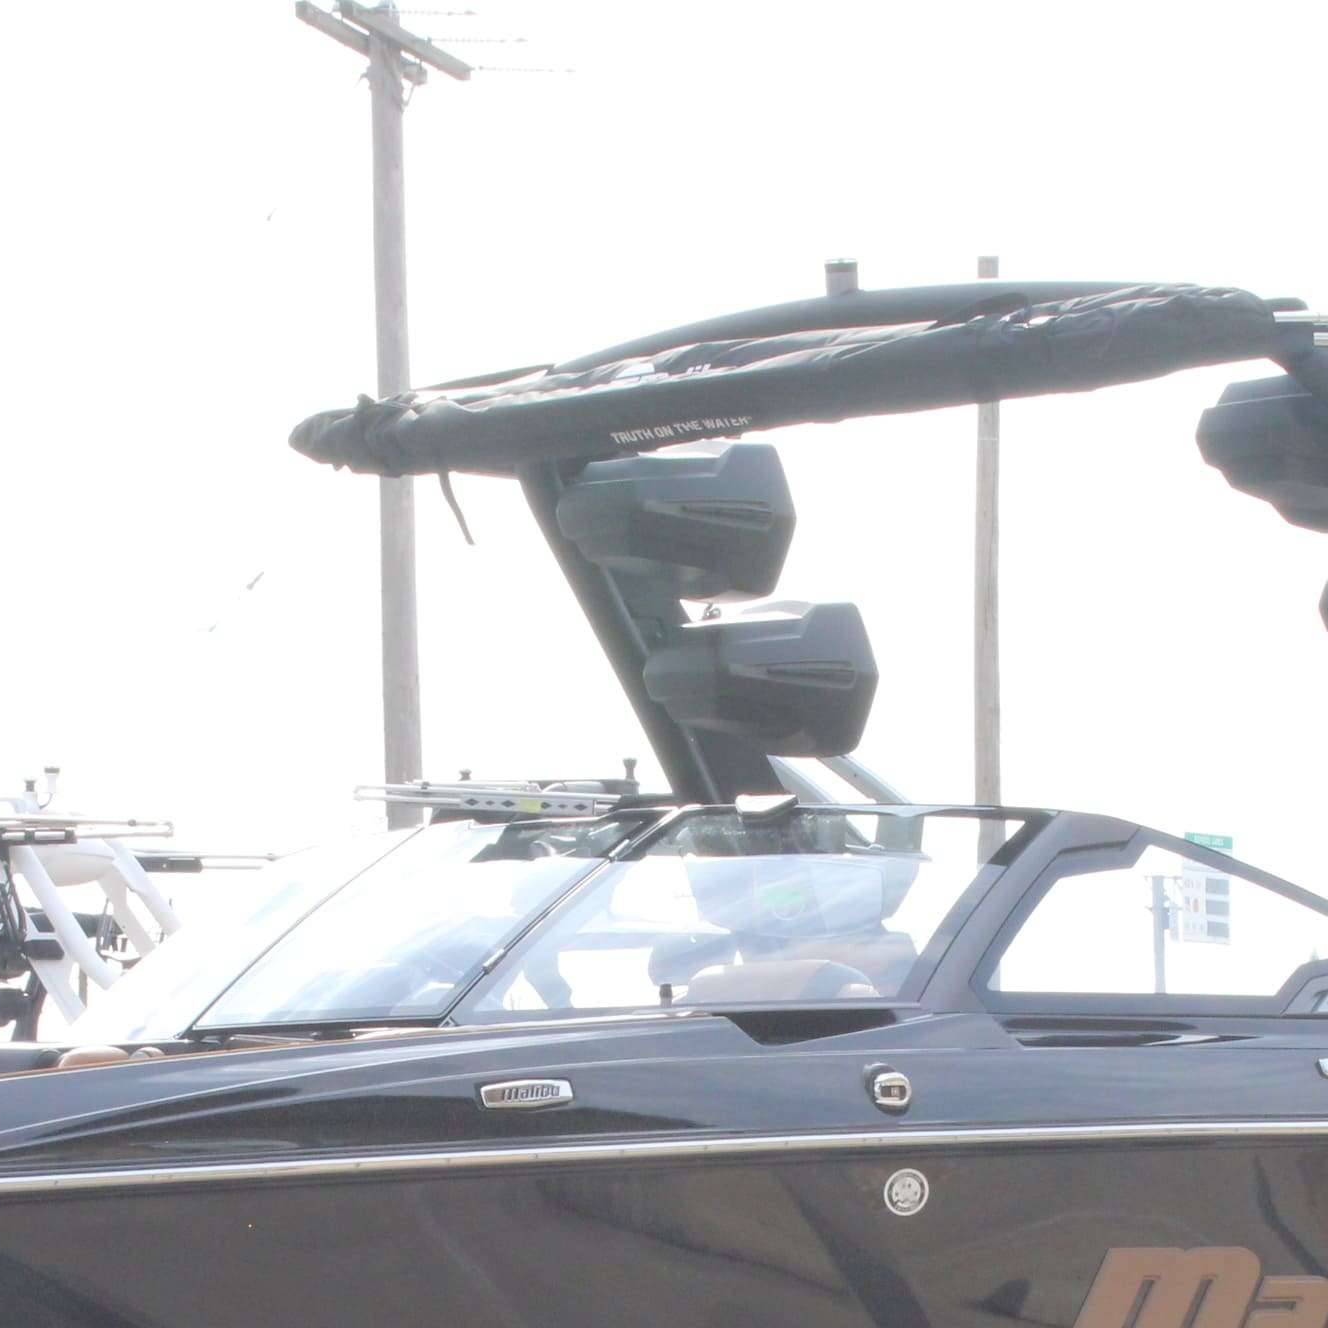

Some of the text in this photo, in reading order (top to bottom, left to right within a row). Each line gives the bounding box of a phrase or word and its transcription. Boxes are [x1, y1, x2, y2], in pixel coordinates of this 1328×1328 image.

[611, 427, 653, 444] TRUTH
[654, 425, 674, 438] ON
[674, 419, 702, 434] THE
[503, 1085, 560, 1103] Malibu
